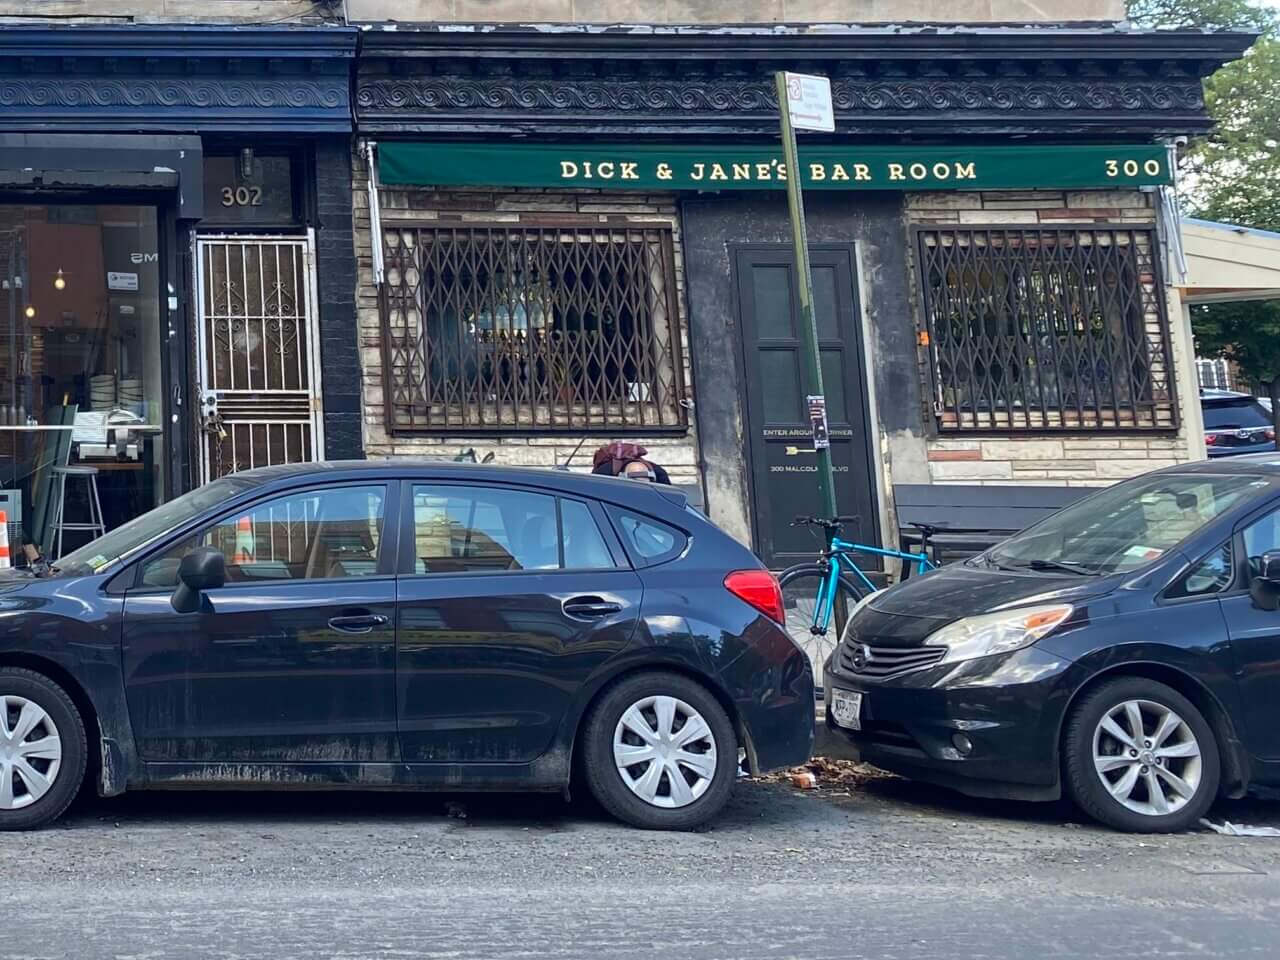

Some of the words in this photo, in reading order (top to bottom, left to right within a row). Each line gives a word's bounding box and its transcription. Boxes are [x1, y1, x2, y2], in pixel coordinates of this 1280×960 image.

[560, 161, 639, 179] DICK
[656, 163, 673, 180] &
[690, 159, 787, 180] JANE'S
[809, 163, 872, 181] BAR
[888, 162, 977, 181] ROOM
[1105, 159, 1160, 177] 300
[221, 186, 261, 206] 302
